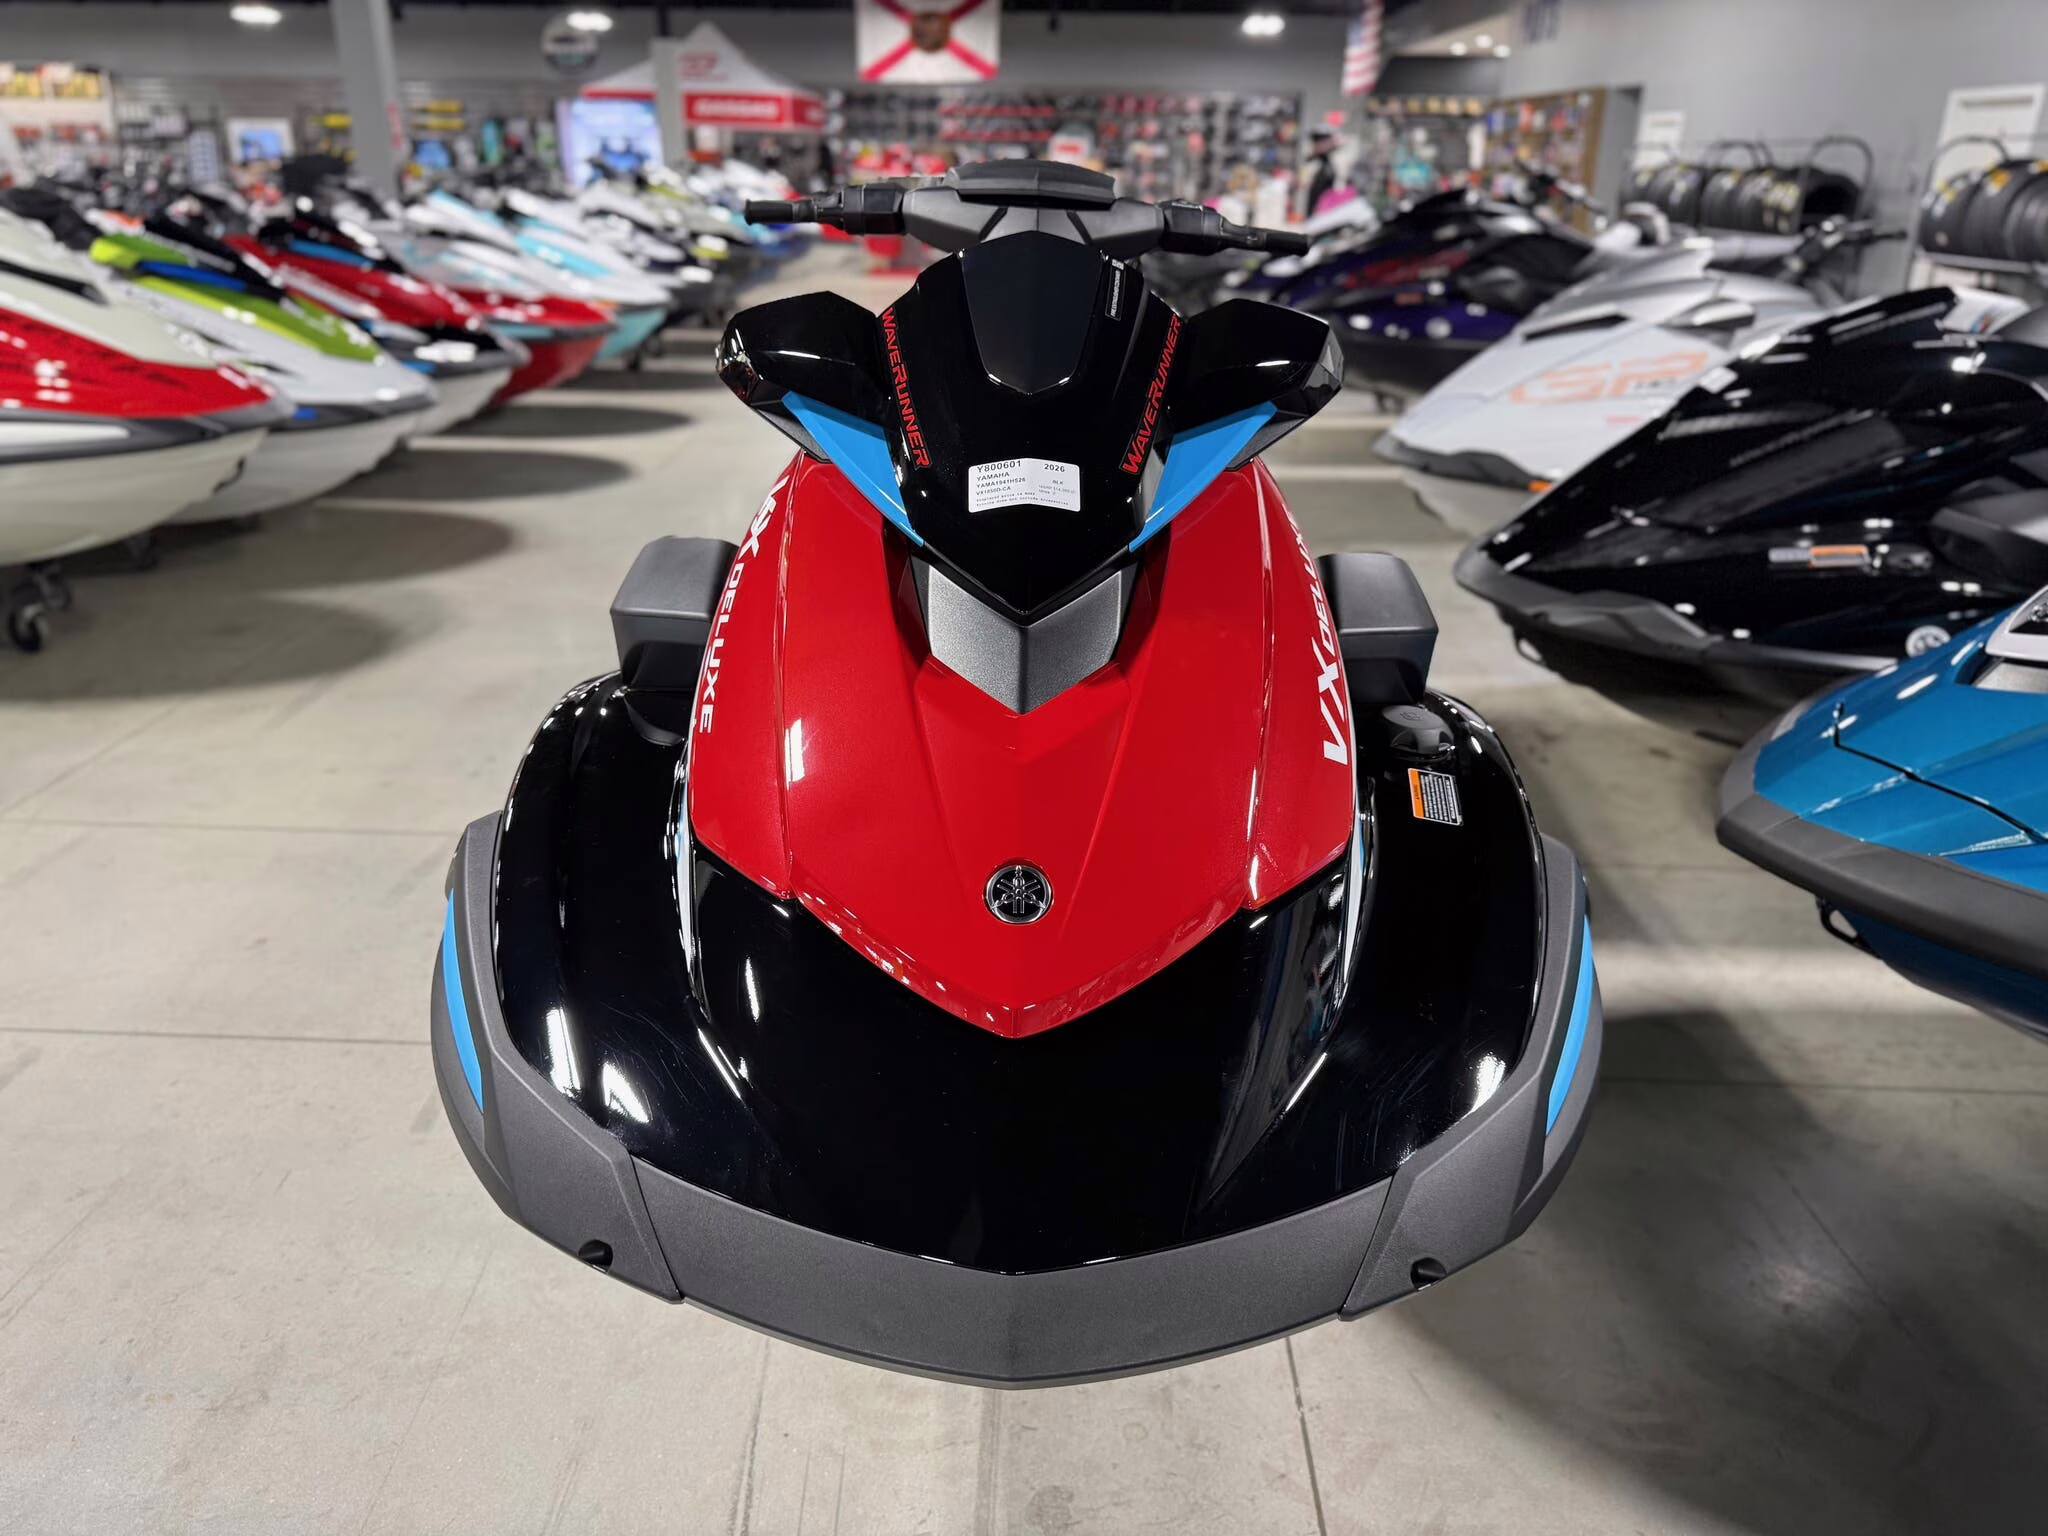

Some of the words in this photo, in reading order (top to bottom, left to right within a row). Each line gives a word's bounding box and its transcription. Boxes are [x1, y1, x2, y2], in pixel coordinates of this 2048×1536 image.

[882, 307, 931, 468] WAVERUNNER
[1122, 313, 1182, 474] WAVERUNNER
[738, 475, 790, 559] VX
[976, 471, 1010, 481] YAMAHA
[977, 460, 1021, 473] Y800601
[1044, 463, 1065, 472] 2026
[699, 562, 745, 734] DELUXE
[1311, 637, 1349, 766] VX
